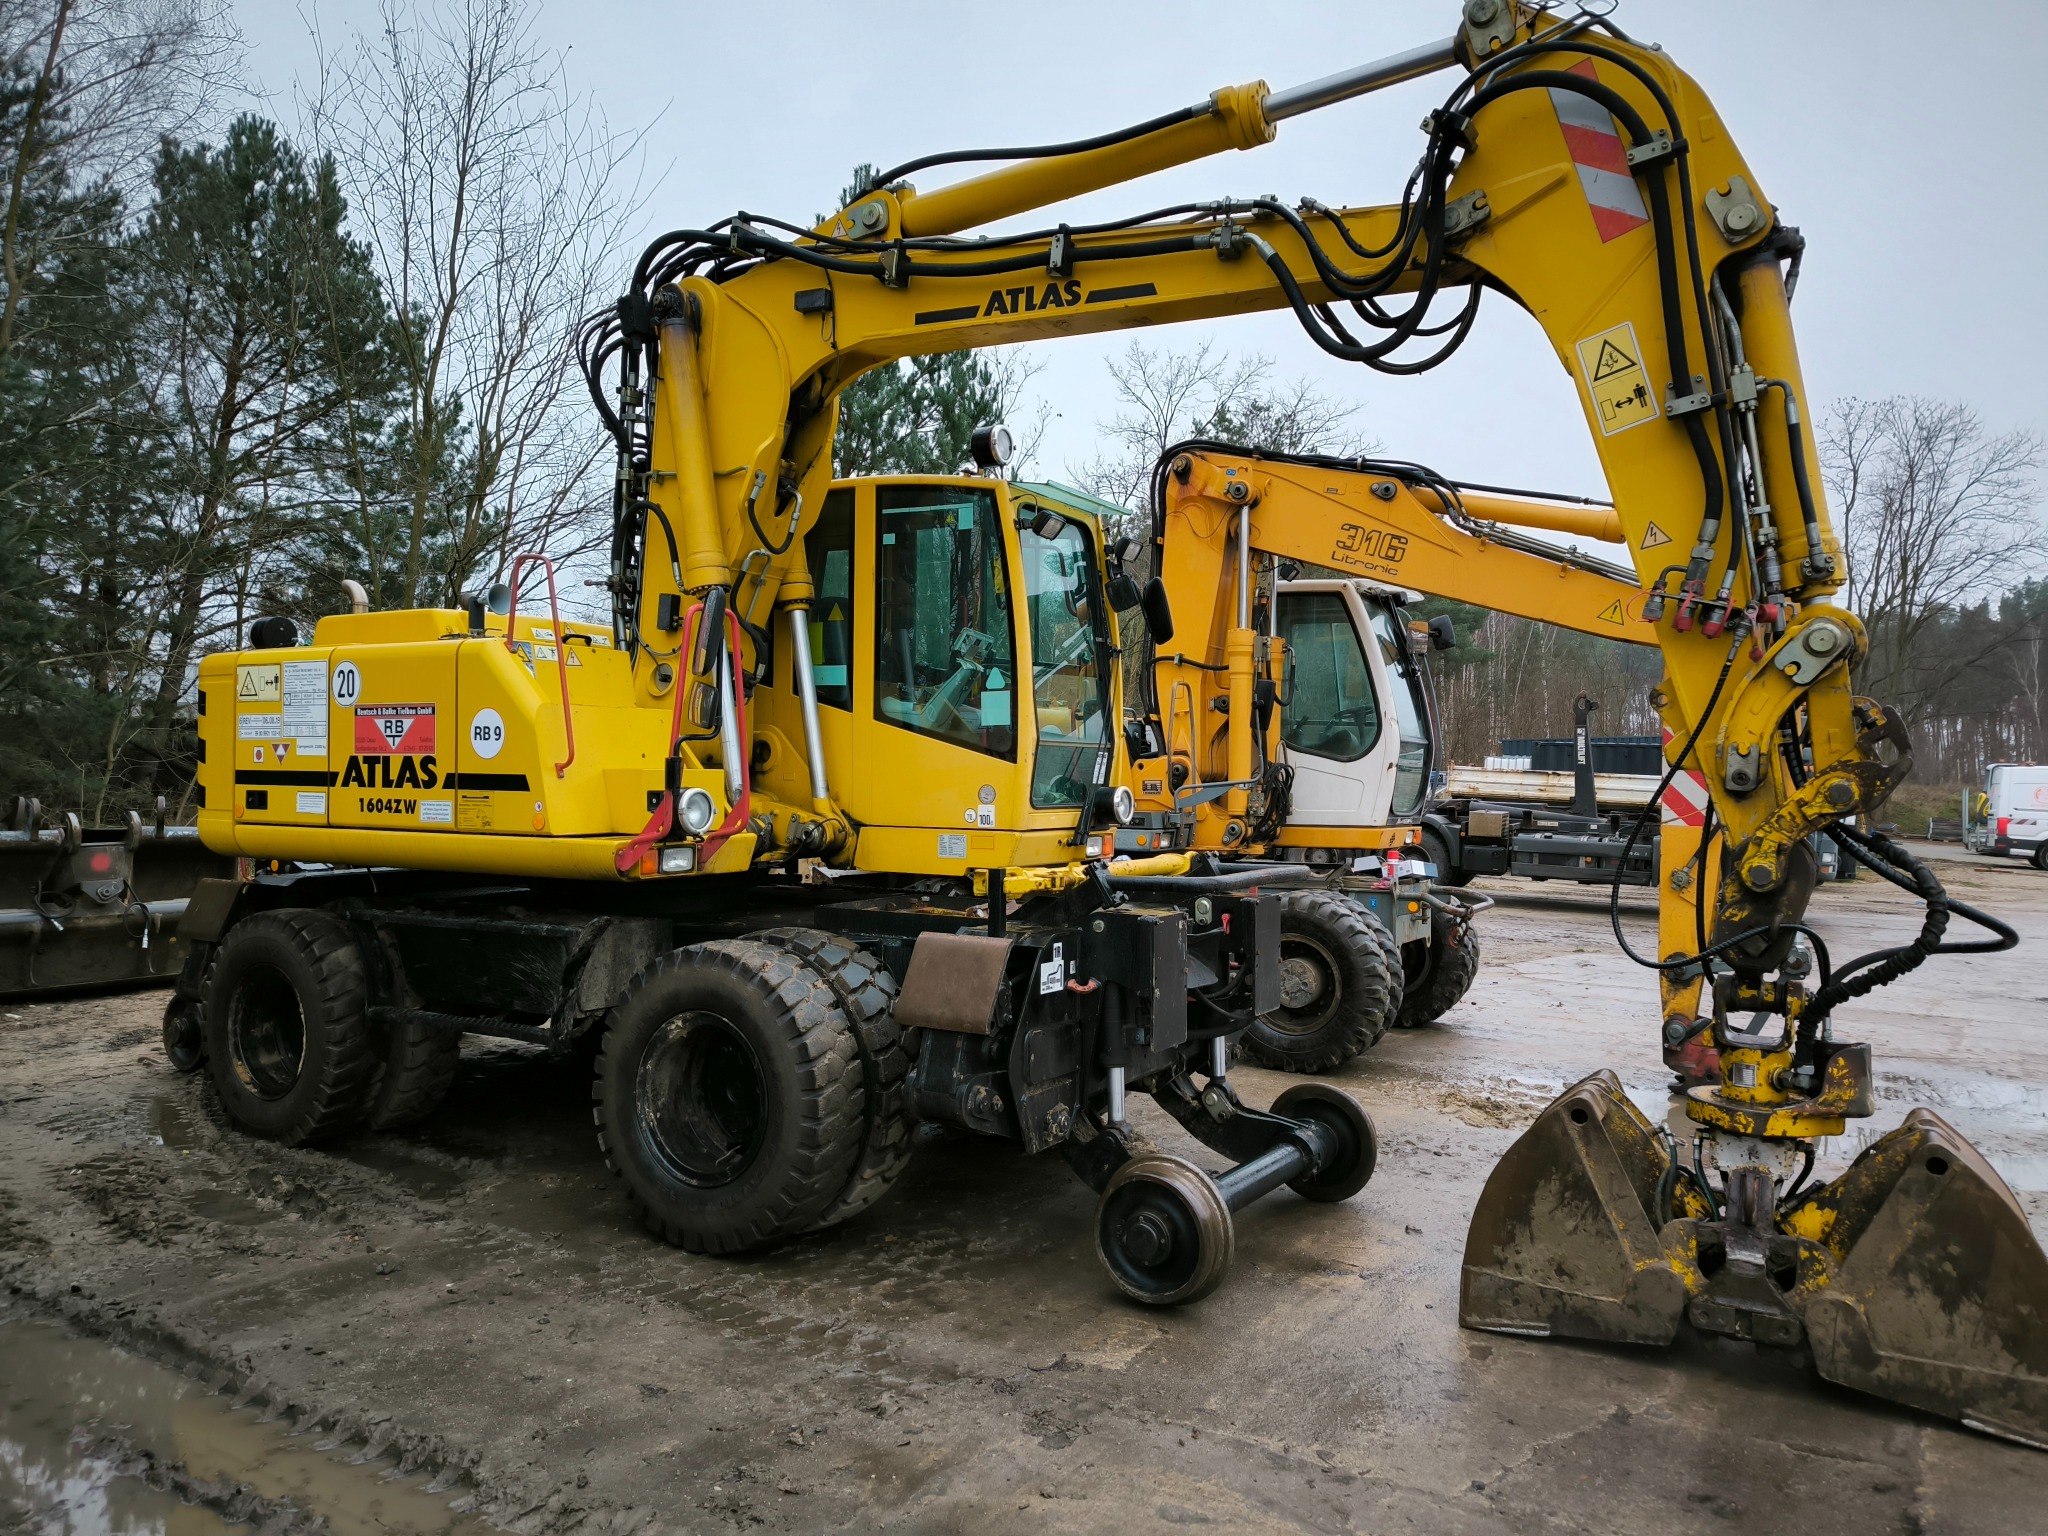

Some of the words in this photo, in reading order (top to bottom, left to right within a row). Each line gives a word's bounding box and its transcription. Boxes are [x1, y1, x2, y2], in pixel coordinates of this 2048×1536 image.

[983, 279, 1082, 317] ATLAS
[1336, 523, 1409, 563] 316
[1331, 550, 1399, 576] Litronic
[337, 669, 355, 699] 20
[397, 707, 417, 715] Tiefbau
[417, 706, 433, 715] GmbH
[384, 720, 404, 734] RB
[474, 726, 491, 741] RB
[493, 726, 501, 741] 9
[385, 734, 403, 747] T
[340, 755, 438, 789] ATLAS
[359, 798, 417, 814] 1604ZW
[979, 814, 991, 826] 100
